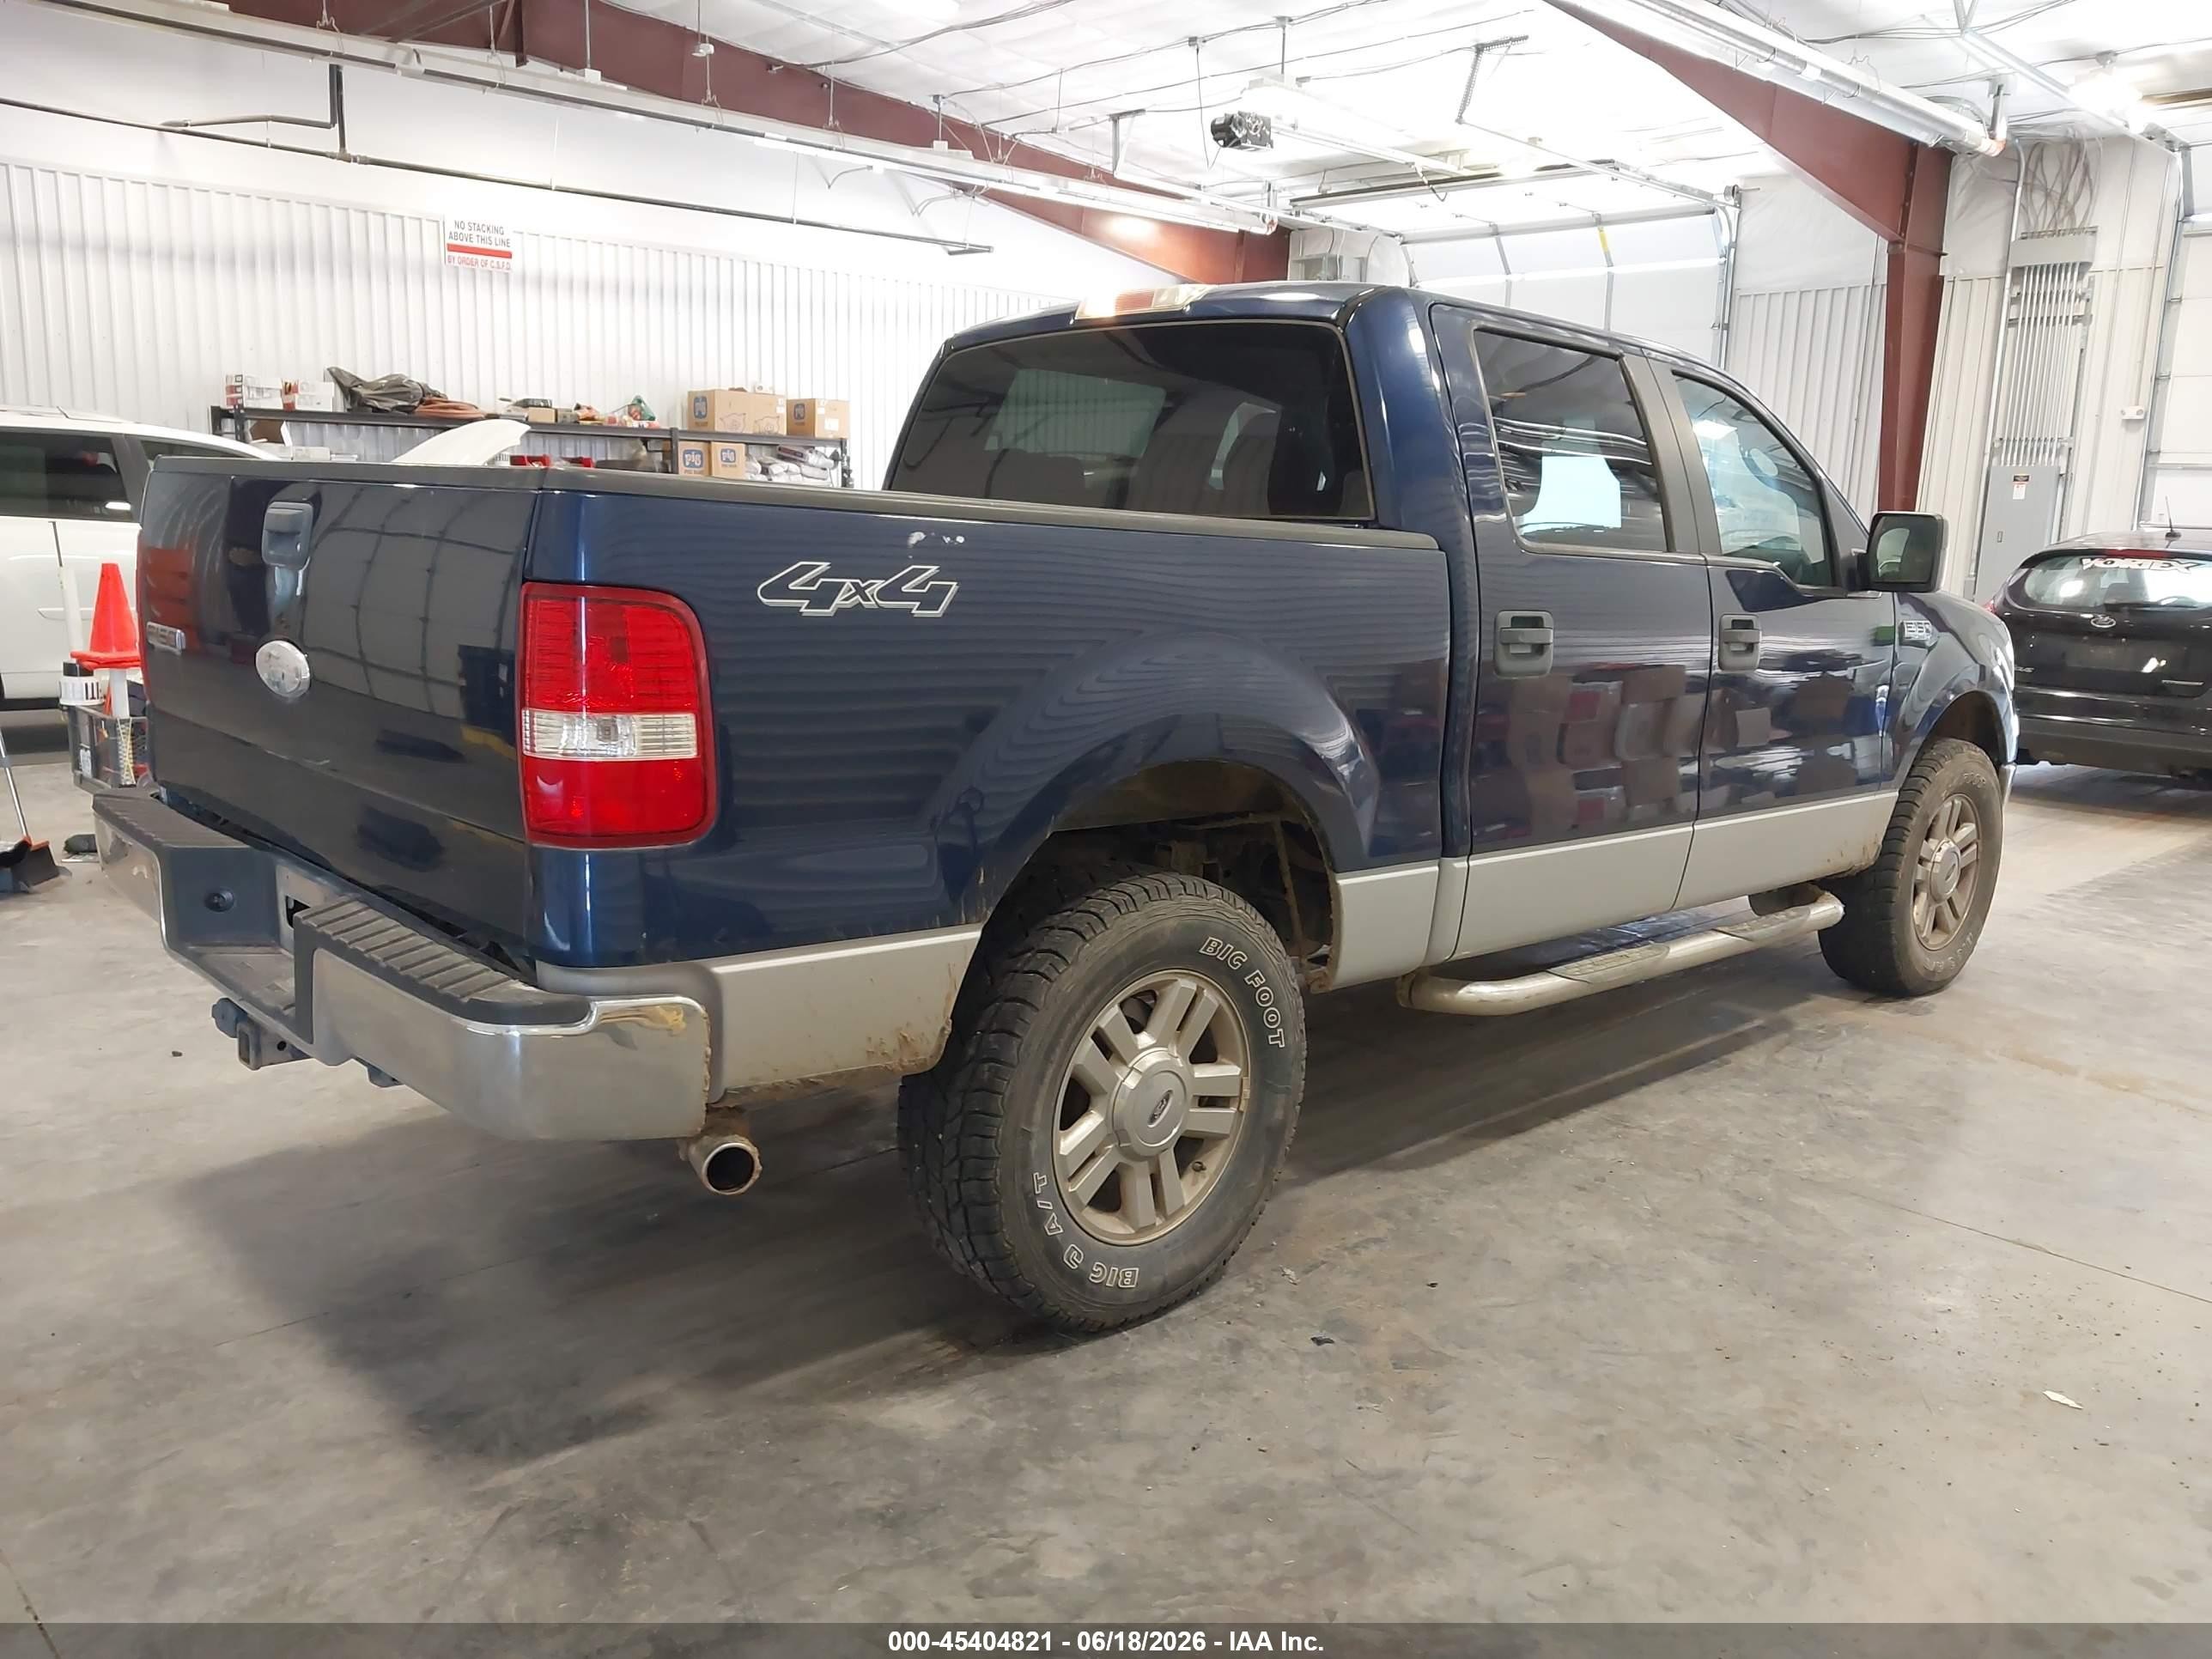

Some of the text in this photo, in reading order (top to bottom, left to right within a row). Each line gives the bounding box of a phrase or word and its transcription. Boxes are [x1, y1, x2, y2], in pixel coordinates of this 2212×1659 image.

[453, 220, 505, 235] NO STACKING
[448, 231, 511, 247] ABOVE THIS LINE
[447, 255, 455, 264] BY
[458, 256, 479, 267] ORDER
[481, 259, 489, 268] OF
[2081, 556, 2204, 574] VORTEX
[1199, 936, 1285, 1048] BIG FOOT
[1032, 1171, 1064, 1236] A/T
[1088, 1261, 1140, 1289] BIG
